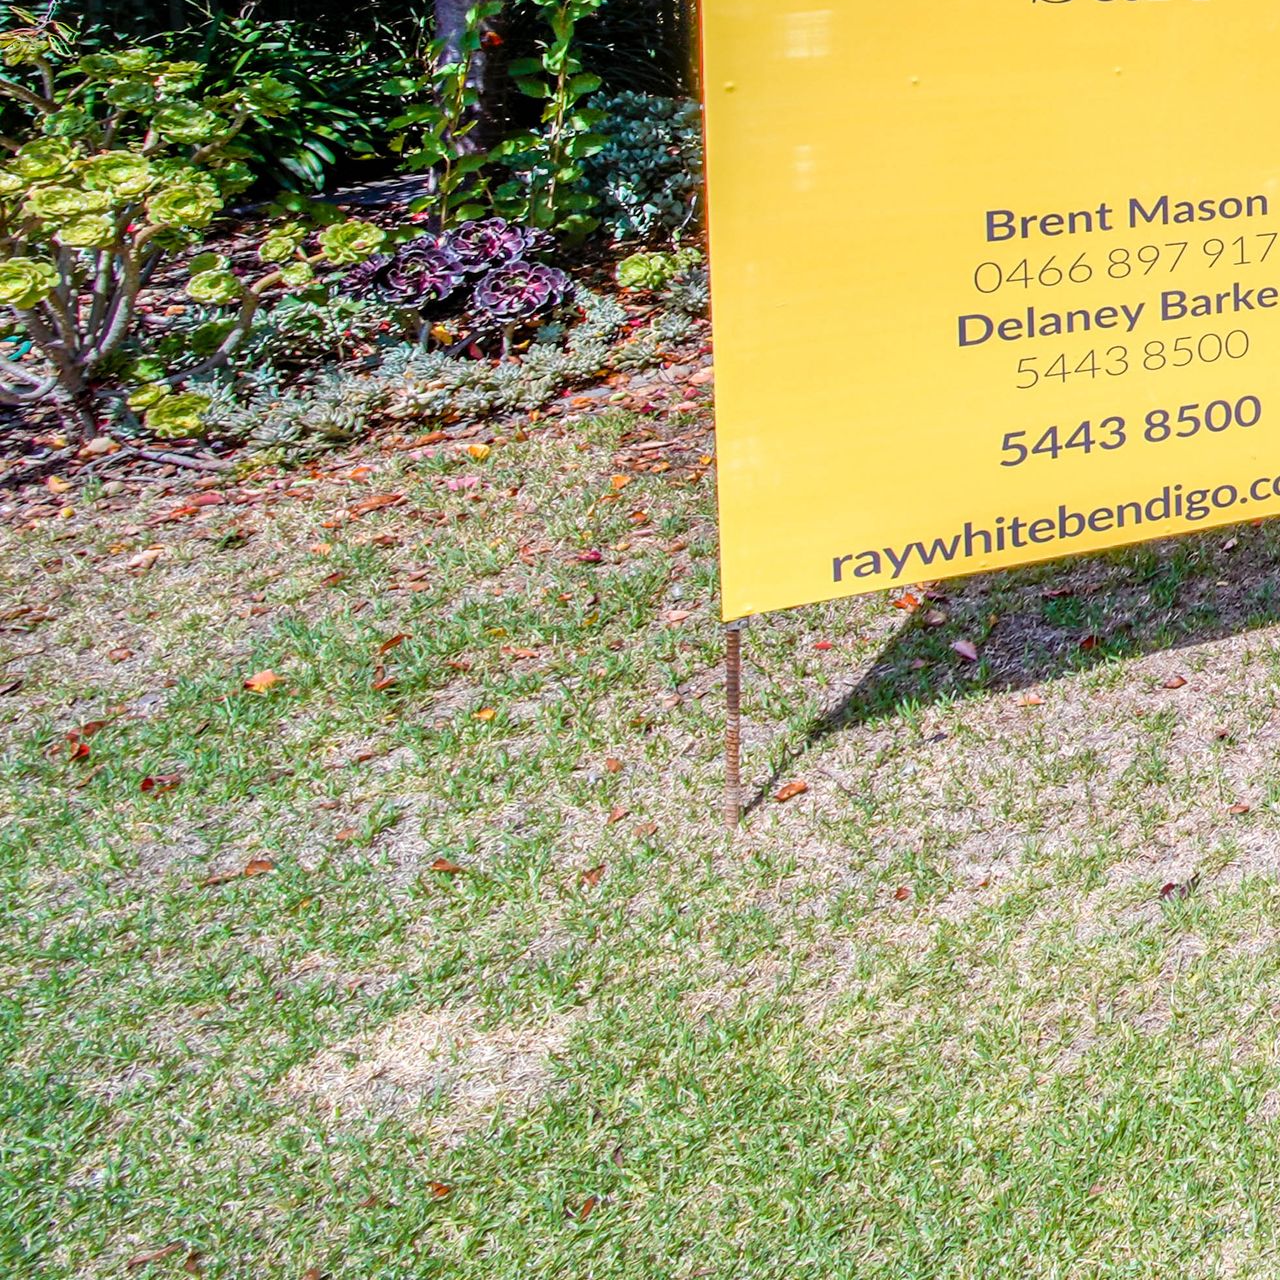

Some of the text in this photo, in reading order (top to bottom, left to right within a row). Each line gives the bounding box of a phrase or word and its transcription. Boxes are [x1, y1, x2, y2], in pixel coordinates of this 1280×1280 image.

[986, 195, 1267, 242] Brent Mason
[974, 233, 1277, 293] 0466 897 917
[958, 303, 1145, 347] Delaney
[1017, 330, 1249, 389] 5443 8500
[1000, 396, 1261, 466] 5443 8500
